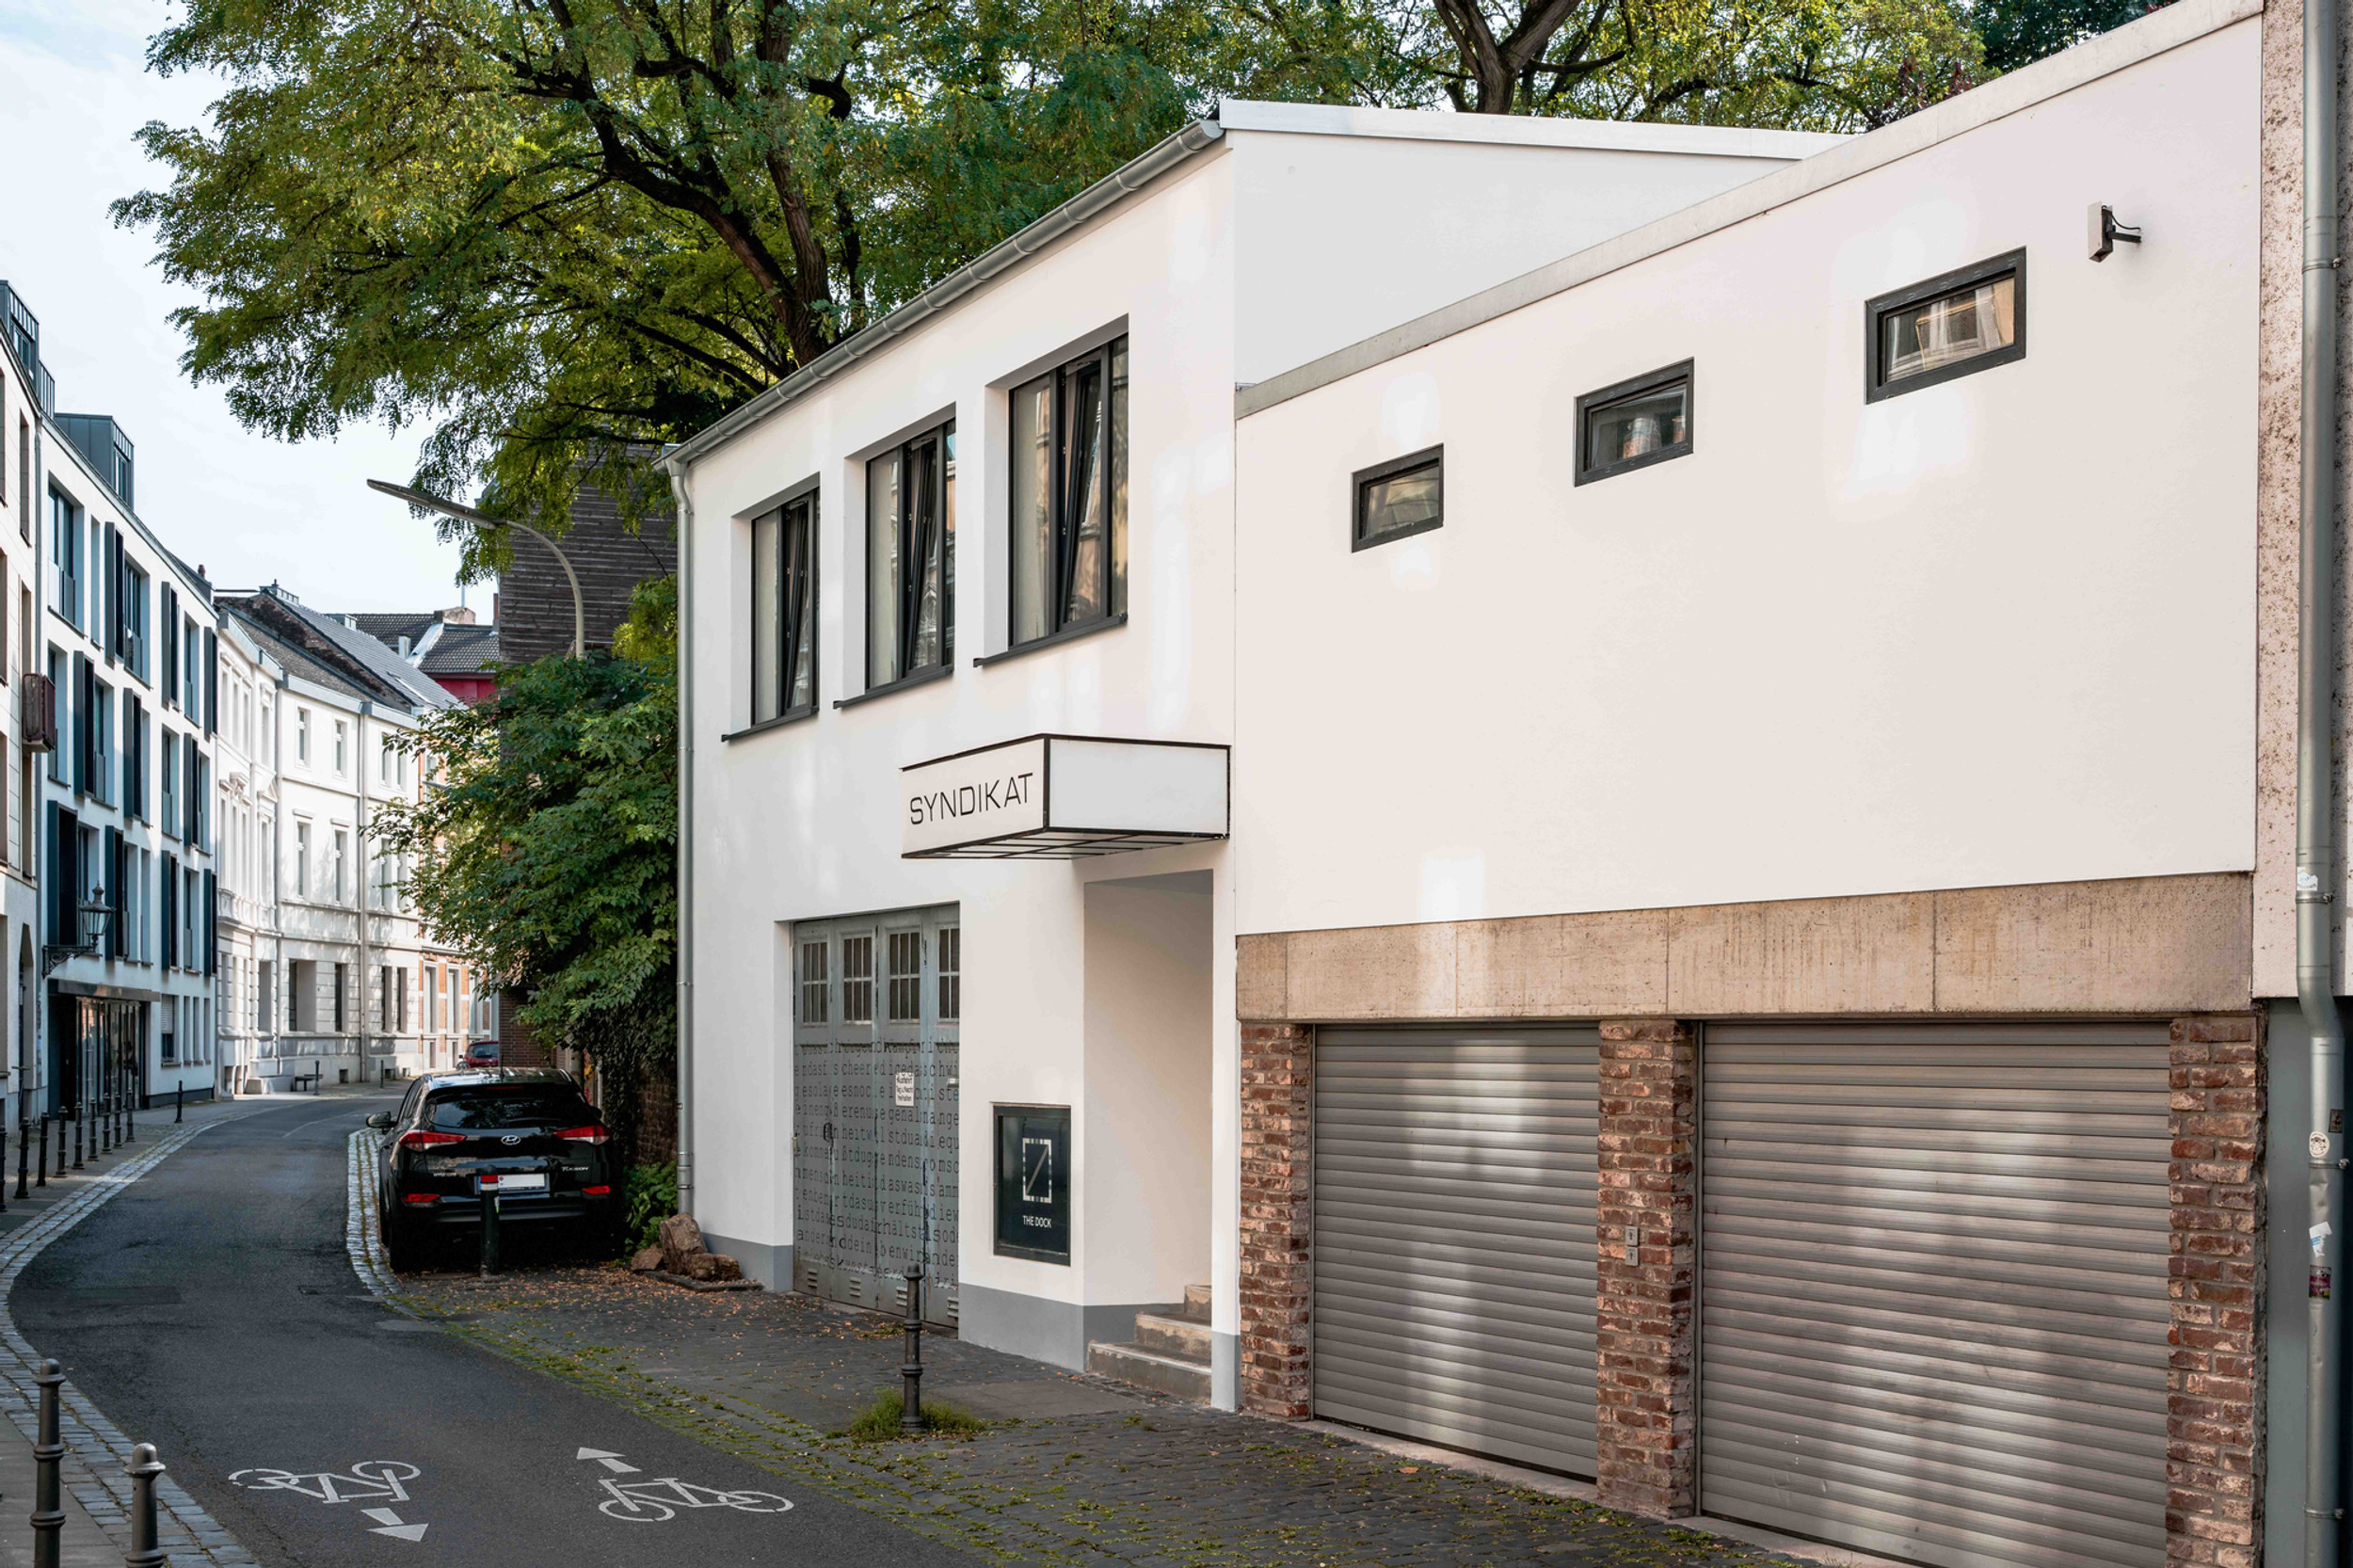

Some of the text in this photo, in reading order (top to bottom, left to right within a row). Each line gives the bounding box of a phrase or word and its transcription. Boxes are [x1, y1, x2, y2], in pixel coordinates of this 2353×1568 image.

[909, 773, 1033, 825] SYNDIKAT
[1022, 1215, 1052, 1229] THE DOCK
